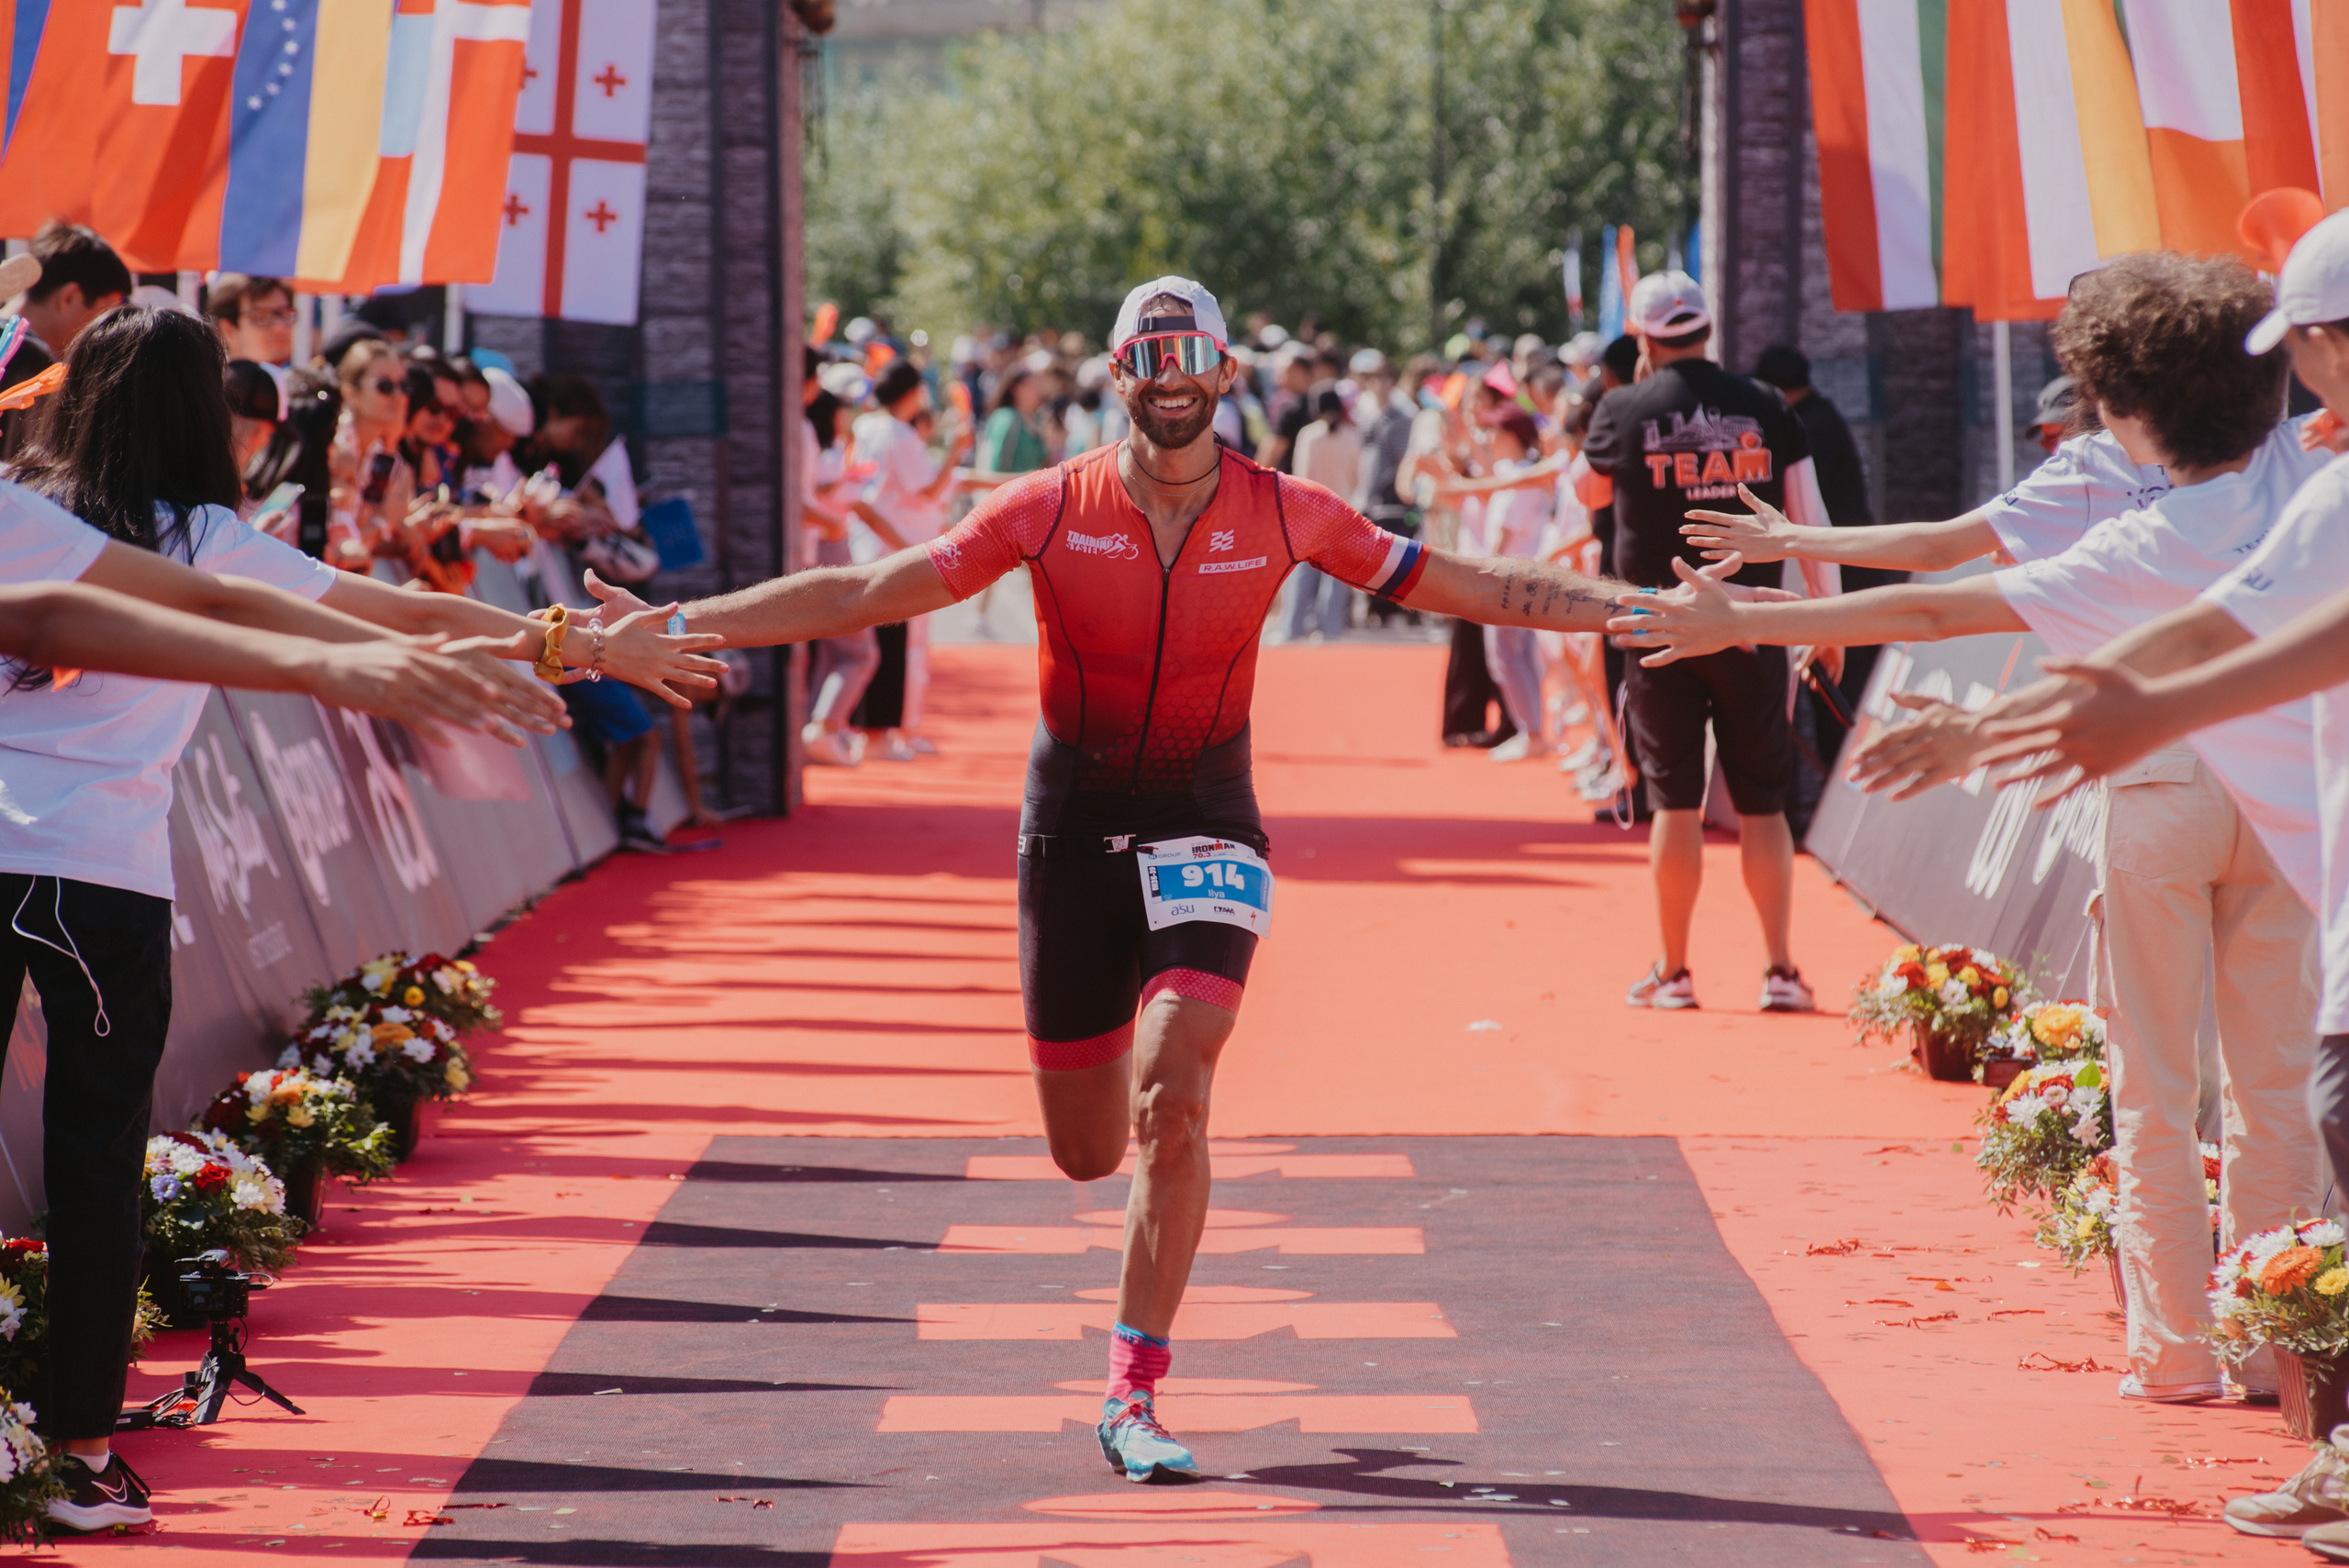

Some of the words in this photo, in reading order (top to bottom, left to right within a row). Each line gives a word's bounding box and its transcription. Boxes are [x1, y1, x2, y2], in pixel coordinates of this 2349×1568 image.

[1644, 431, 1772, 489] TEAM
[1191, 840, 1236, 853] IRONMAN
[1181, 862, 1245, 891] 914
[1208, 888, 1226, 899] Ilya
